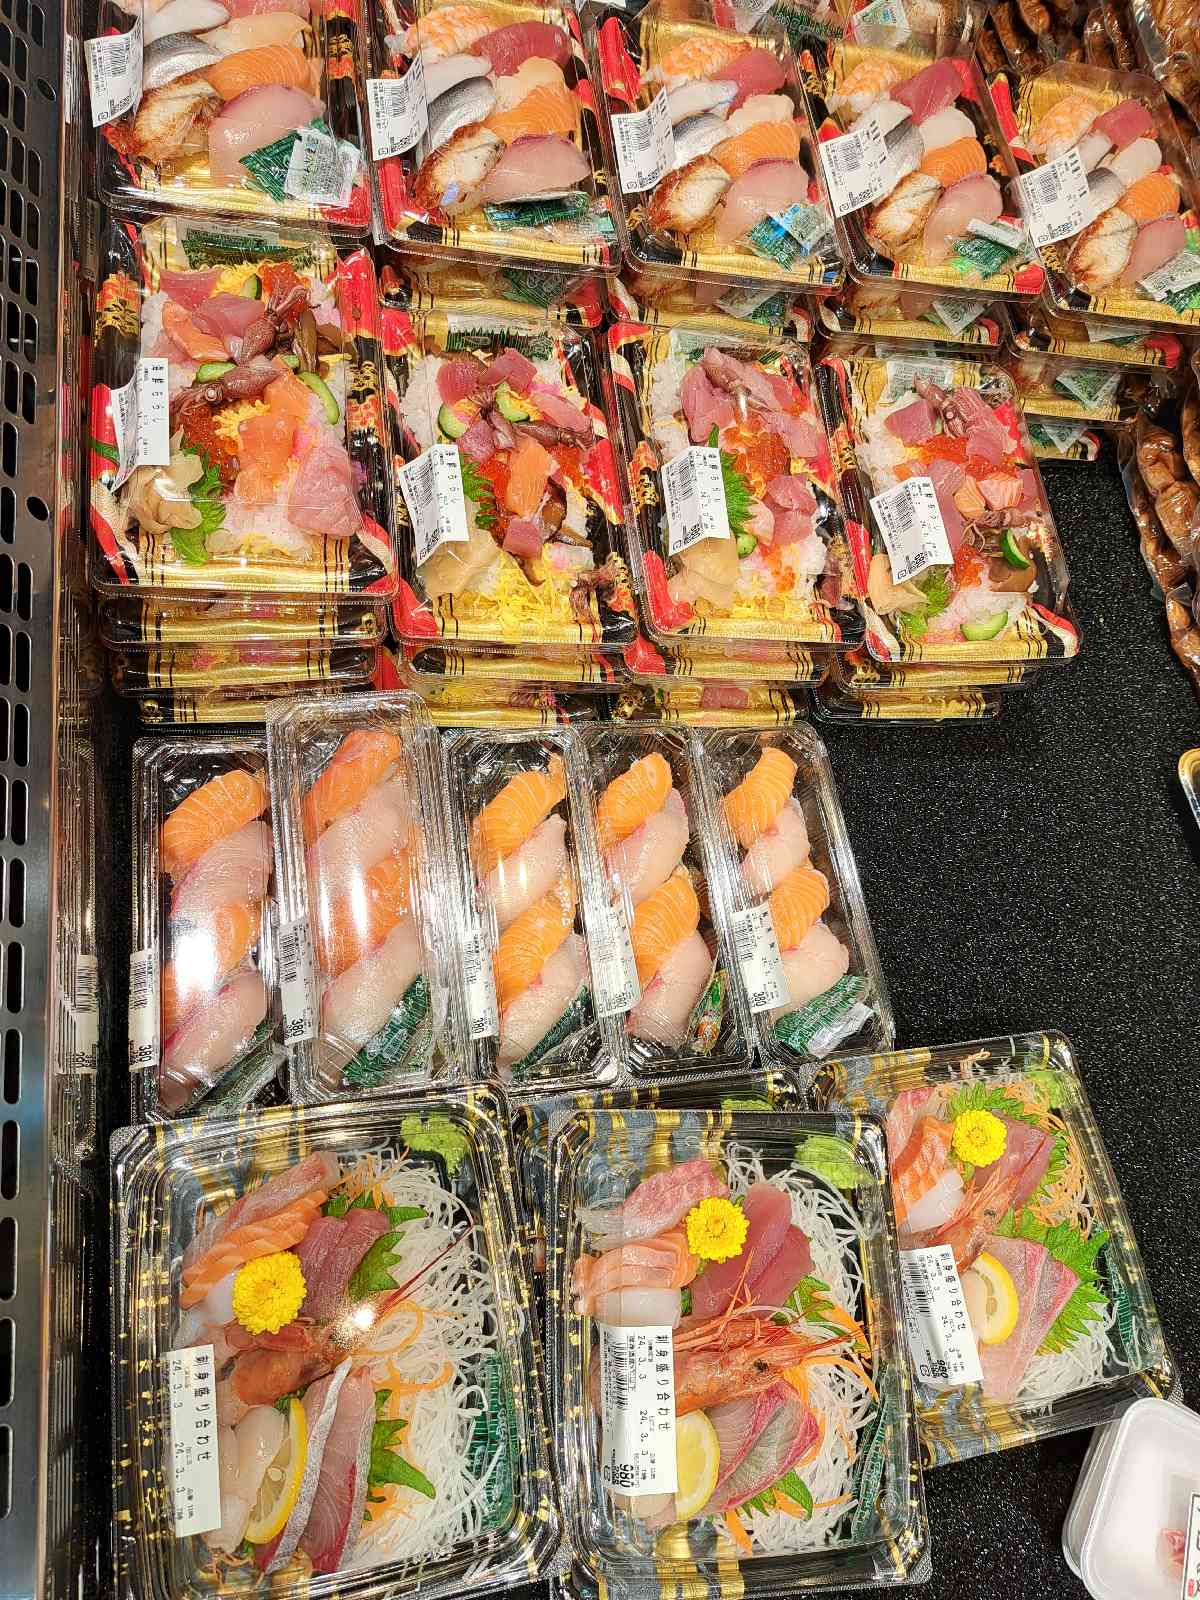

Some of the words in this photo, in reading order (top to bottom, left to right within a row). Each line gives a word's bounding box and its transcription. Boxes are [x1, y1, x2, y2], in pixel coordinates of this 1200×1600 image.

[753, 991, 767, 1007] 380
[291, 1017, 305, 1037] 380
[138, 1044, 152, 1063] 380
[940, 1252, 966, 1331] 刺身盛り合わせ
[936, 1359, 949, 1379] 980
[655, 1334, 671, 1431] 刺身盛り合わせ
[194, 1355, 212, 1462] 刺身盛り合わせ
[619, 1463, 634, 1488] 980
